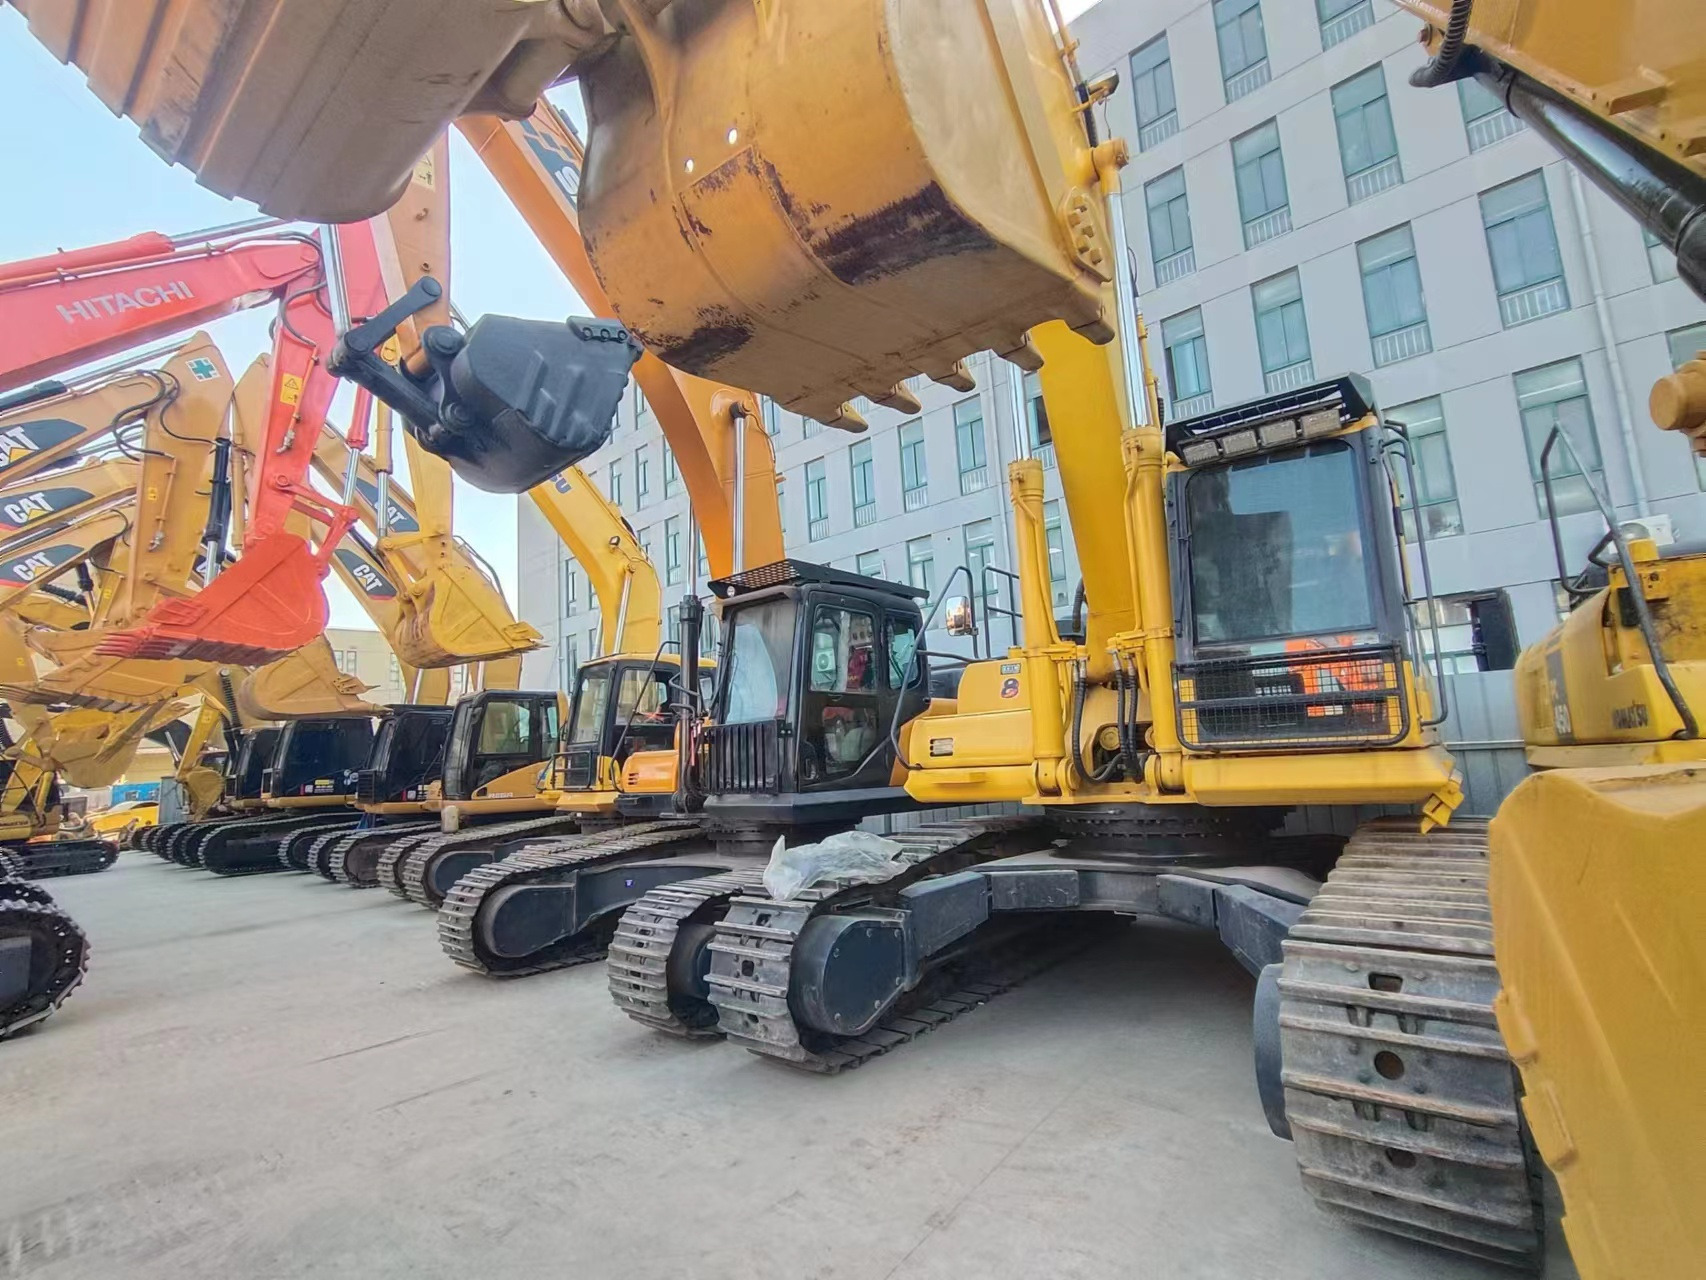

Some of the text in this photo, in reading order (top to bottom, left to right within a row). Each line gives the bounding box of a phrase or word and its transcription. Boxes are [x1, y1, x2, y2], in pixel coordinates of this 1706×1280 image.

[56, 281, 195, 324] HITACHI
[4, 492, 54, 524] CAT
[13, 552, 55, 581] CAT
[353, 564, 382, 591] CAT
